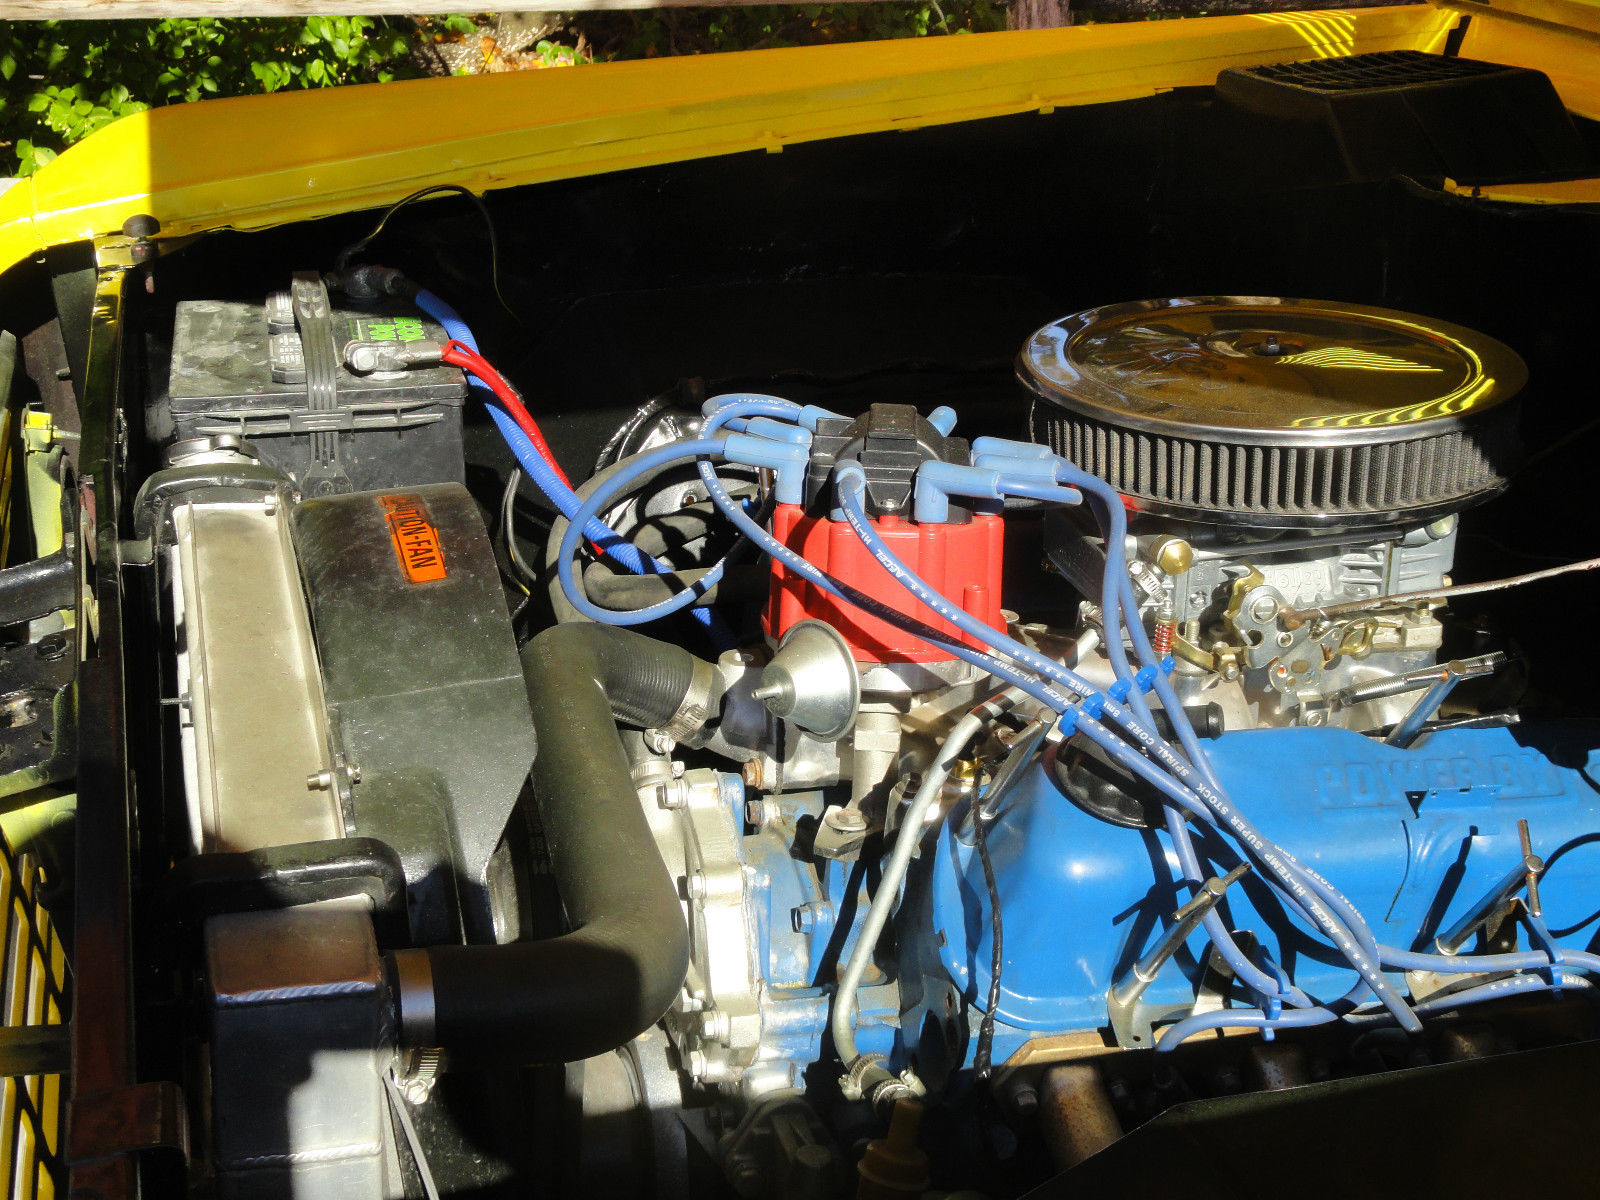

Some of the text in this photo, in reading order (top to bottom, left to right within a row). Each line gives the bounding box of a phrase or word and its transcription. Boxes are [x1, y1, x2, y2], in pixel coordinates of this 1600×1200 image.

[844, 510, 872, 544] HI-TEMP
[876, 548, 910, 579] ACCEL
[994, 659, 1037, 684] HI-TEMP
[1041, 686, 1074, 707] ACCEL
[1126, 720, 1155, 747] CORE
[1156, 747, 1190, 776] SPIRAL
[1196, 782, 1229, 815] STOCK
[1230, 815, 1264, 850] SUPER
[1264, 853, 1307, 898] HI-TEMP
[1310, 902, 1340, 934] ACCEL
